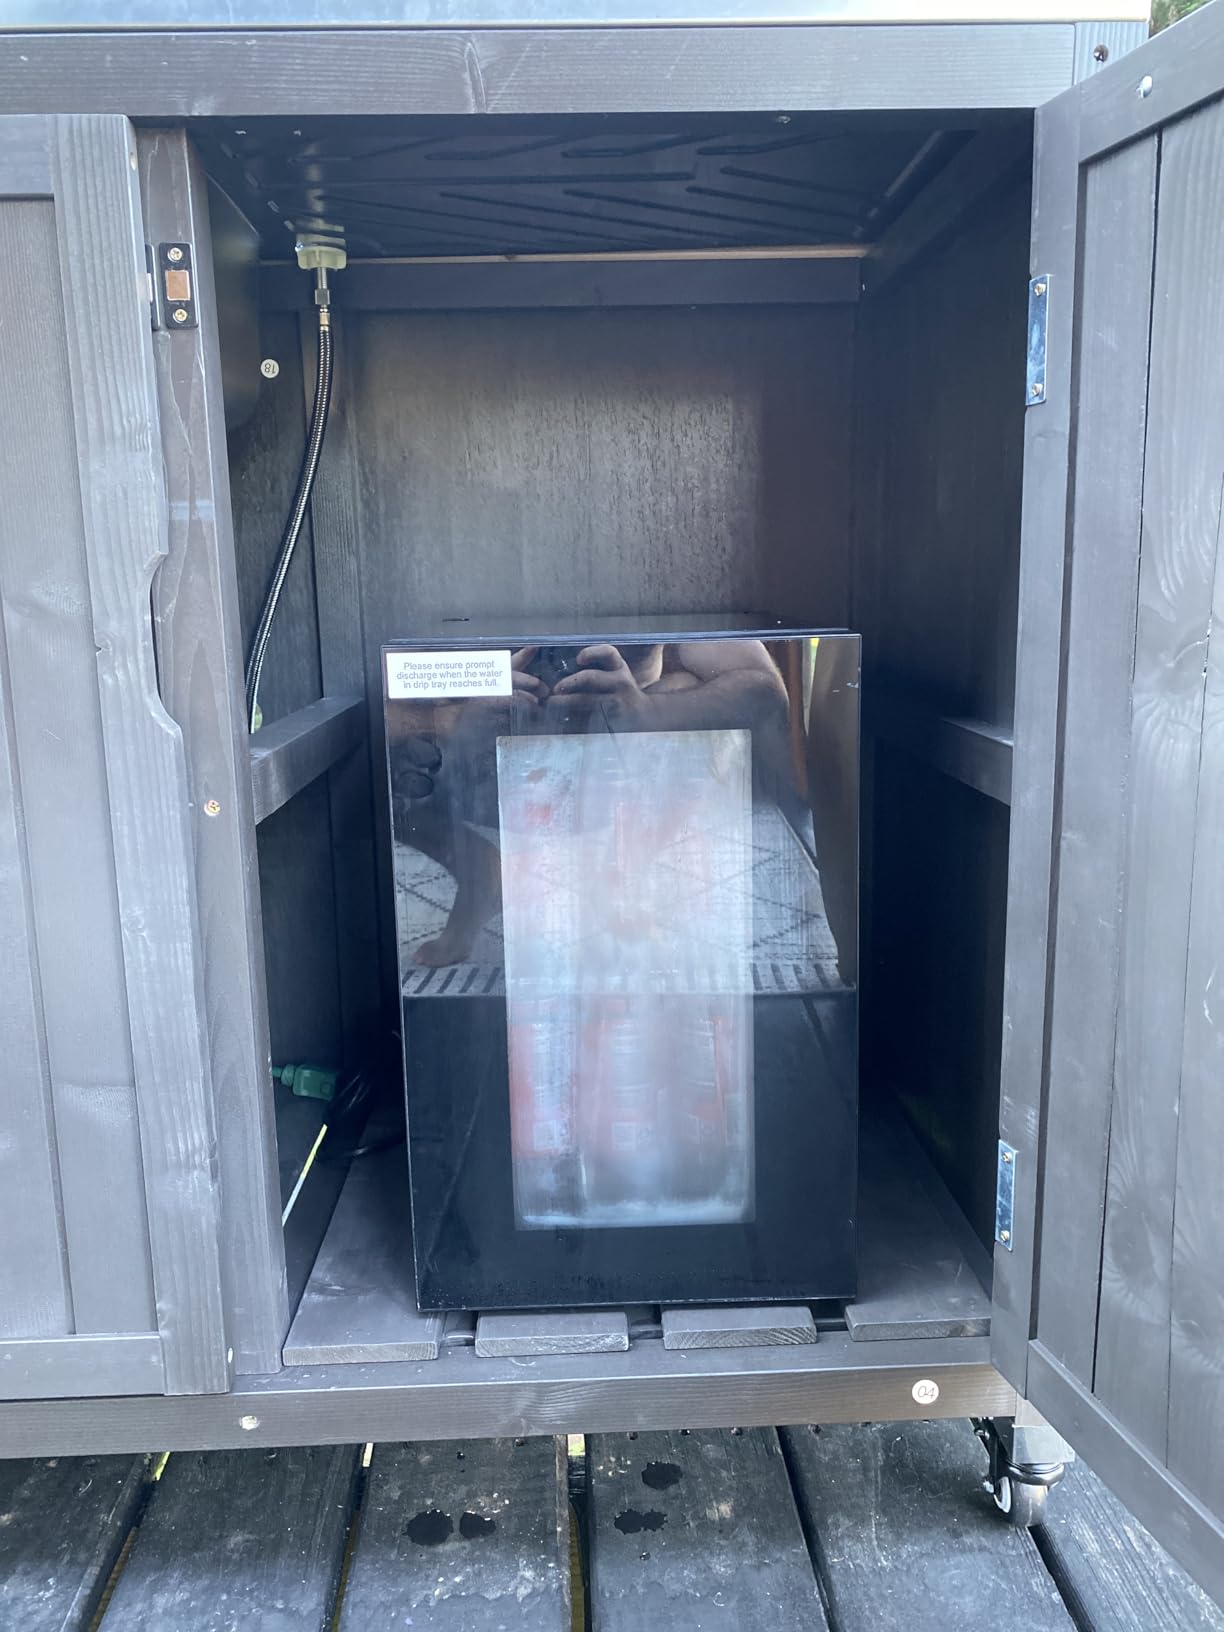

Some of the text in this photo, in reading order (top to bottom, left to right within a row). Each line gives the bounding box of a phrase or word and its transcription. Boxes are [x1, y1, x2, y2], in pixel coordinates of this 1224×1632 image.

[403, 660, 495, 671] Please ensure prompt
[396, 669, 504, 681] discharge when the water
[403, 681, 412, 689] in
[413, 680, 429, 690] drip
[431, 680, 447, 690] tray
[449, 679, 482, 688] reaches
